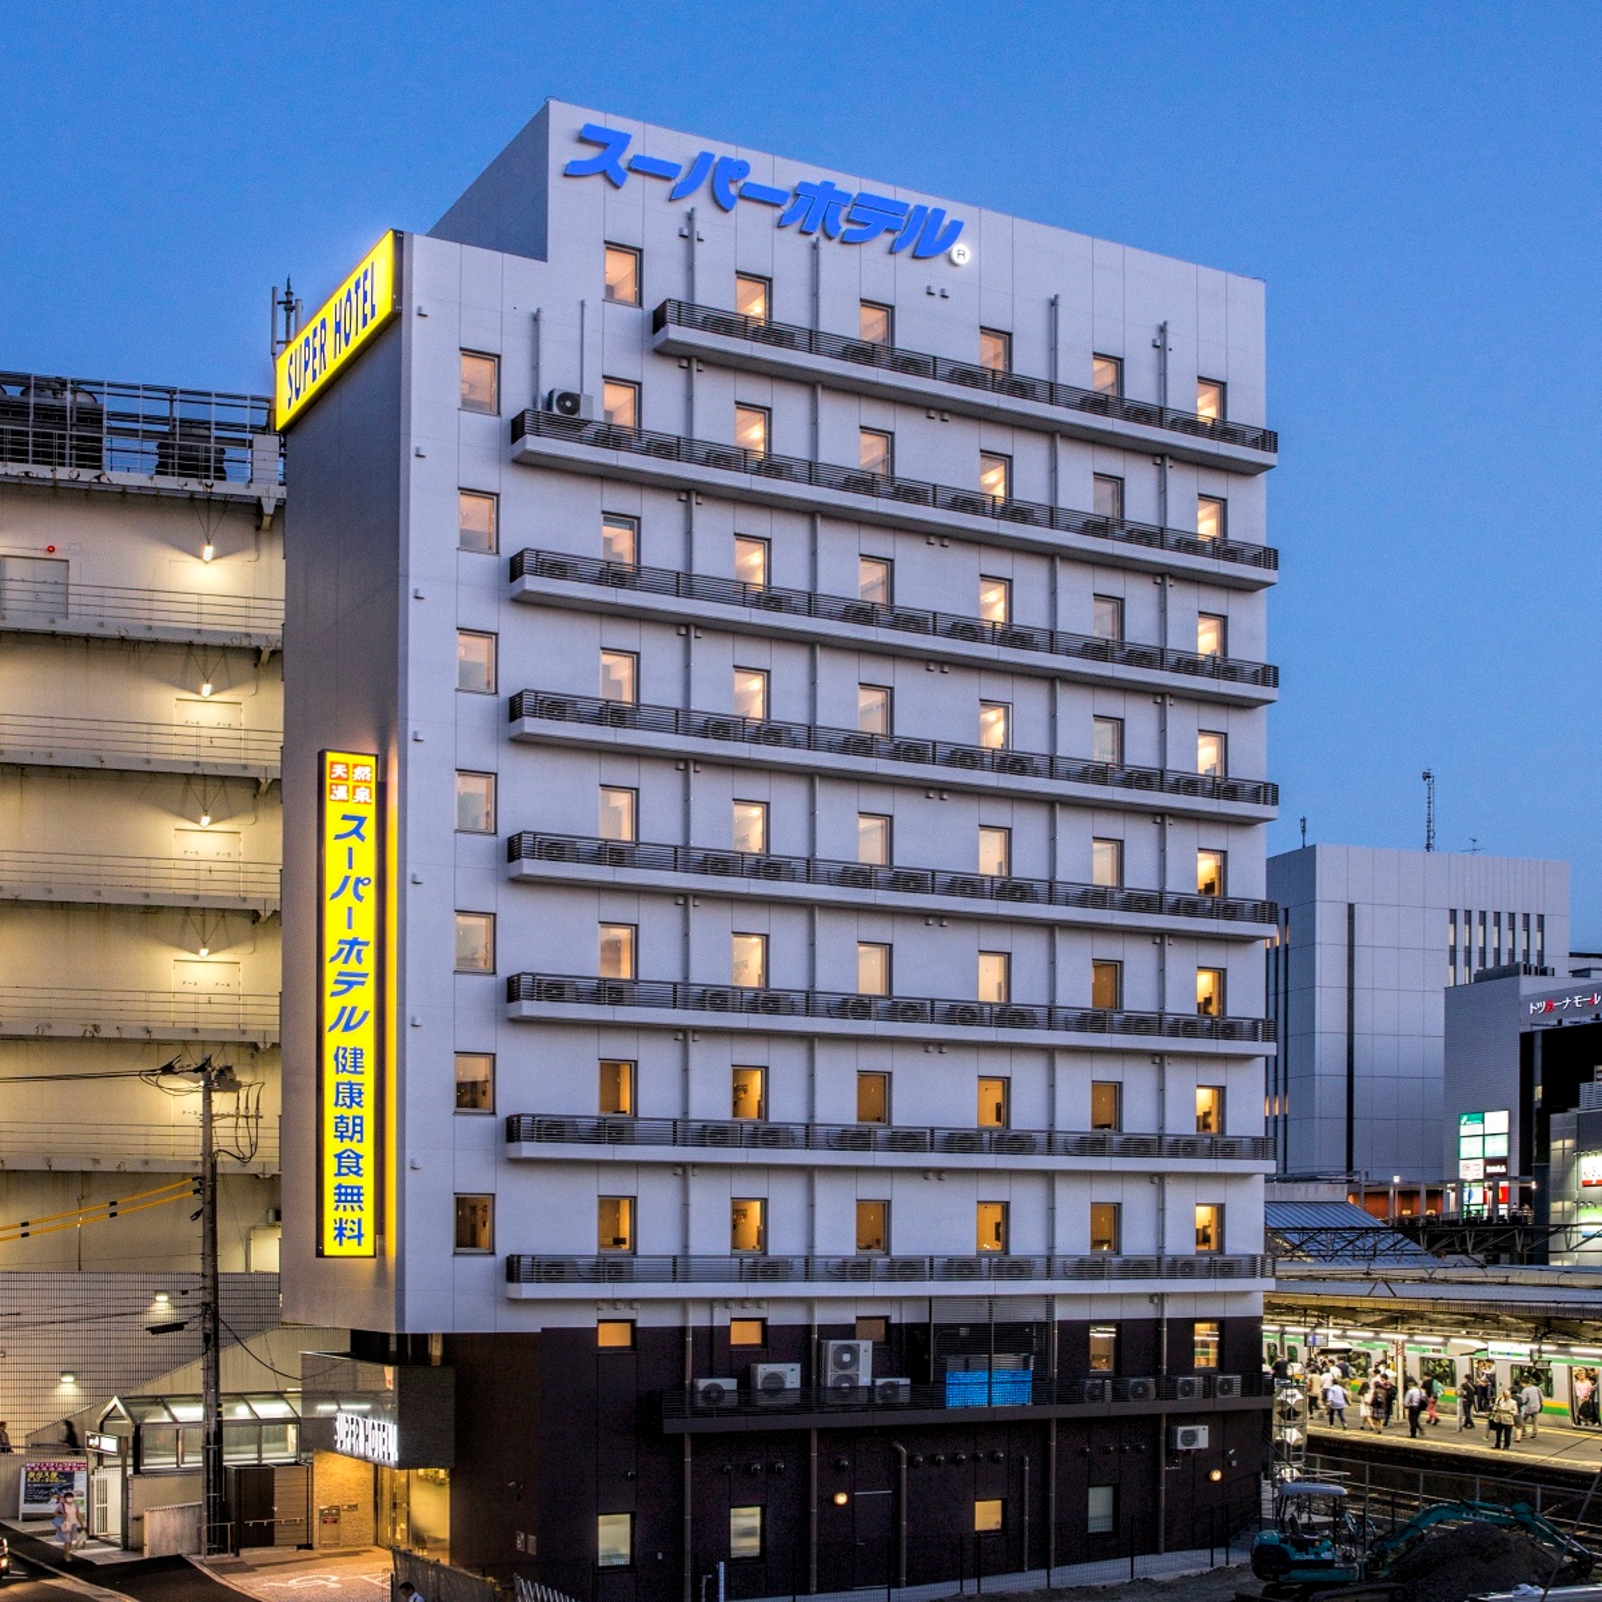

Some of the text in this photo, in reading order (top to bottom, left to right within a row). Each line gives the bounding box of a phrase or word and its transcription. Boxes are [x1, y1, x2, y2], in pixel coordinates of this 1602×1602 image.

[563, 123, 965, 259] スーパーホテル
[288, 261, 376, 410] SUPER HOTEL
[330, 762, 373, 783] 天然
[330, 783, 373, 804] 温泉
[327, 813, 371, 1033] スーパーホテル
[333, 1045, 365, 1247] 健康朝食無料
[362, 1417, 396, 1461] HOTEL
